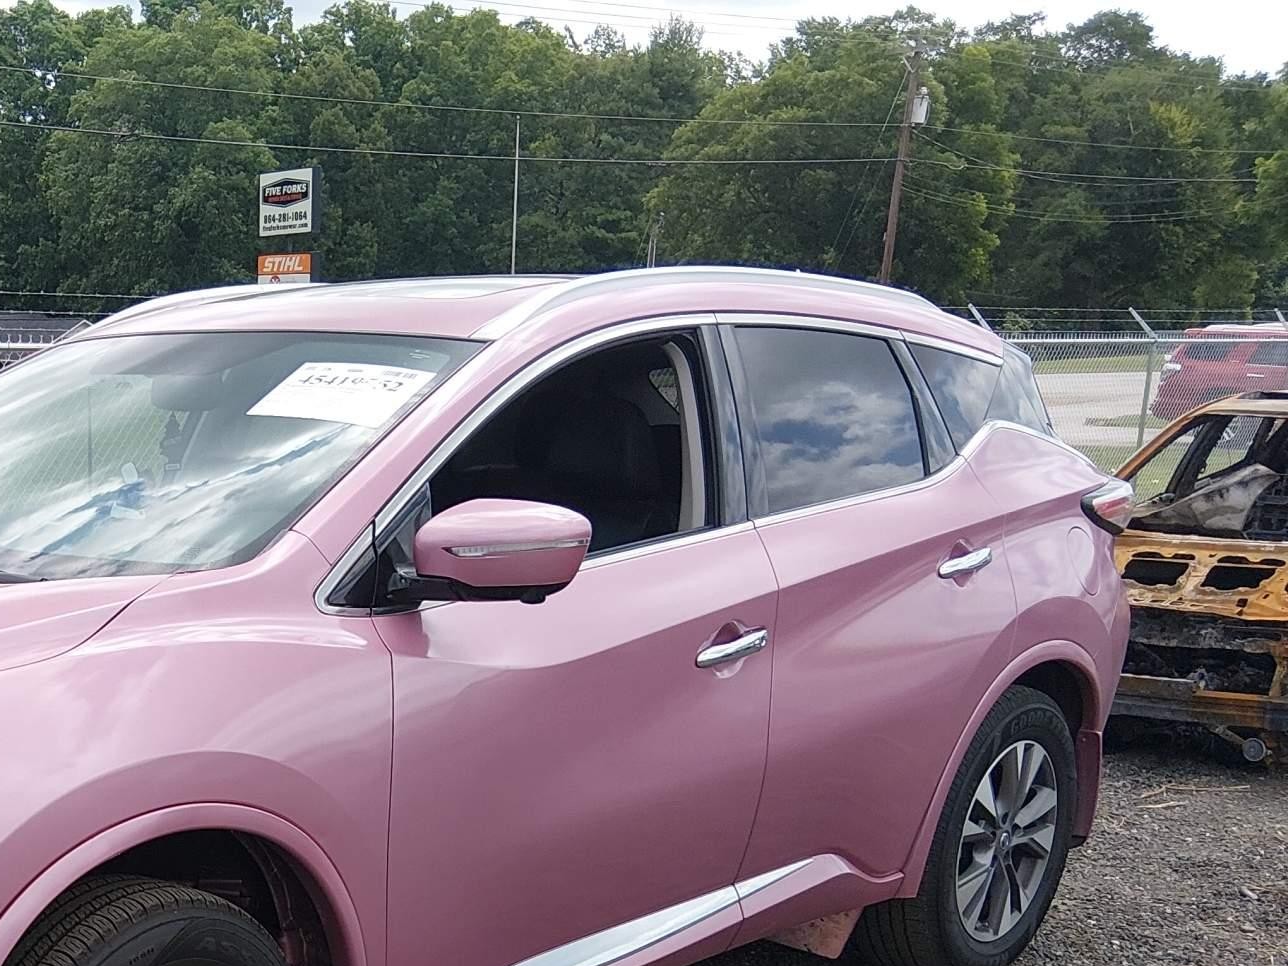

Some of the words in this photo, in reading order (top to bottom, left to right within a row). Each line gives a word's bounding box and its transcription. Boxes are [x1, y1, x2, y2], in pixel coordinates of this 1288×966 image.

[265, 187, 282, 196] FIVE
[282, 183, 306, 194] FORKS
[264, 211, 307, 224] 864-281-1064
[263, 256, 303, 271] STIHL
